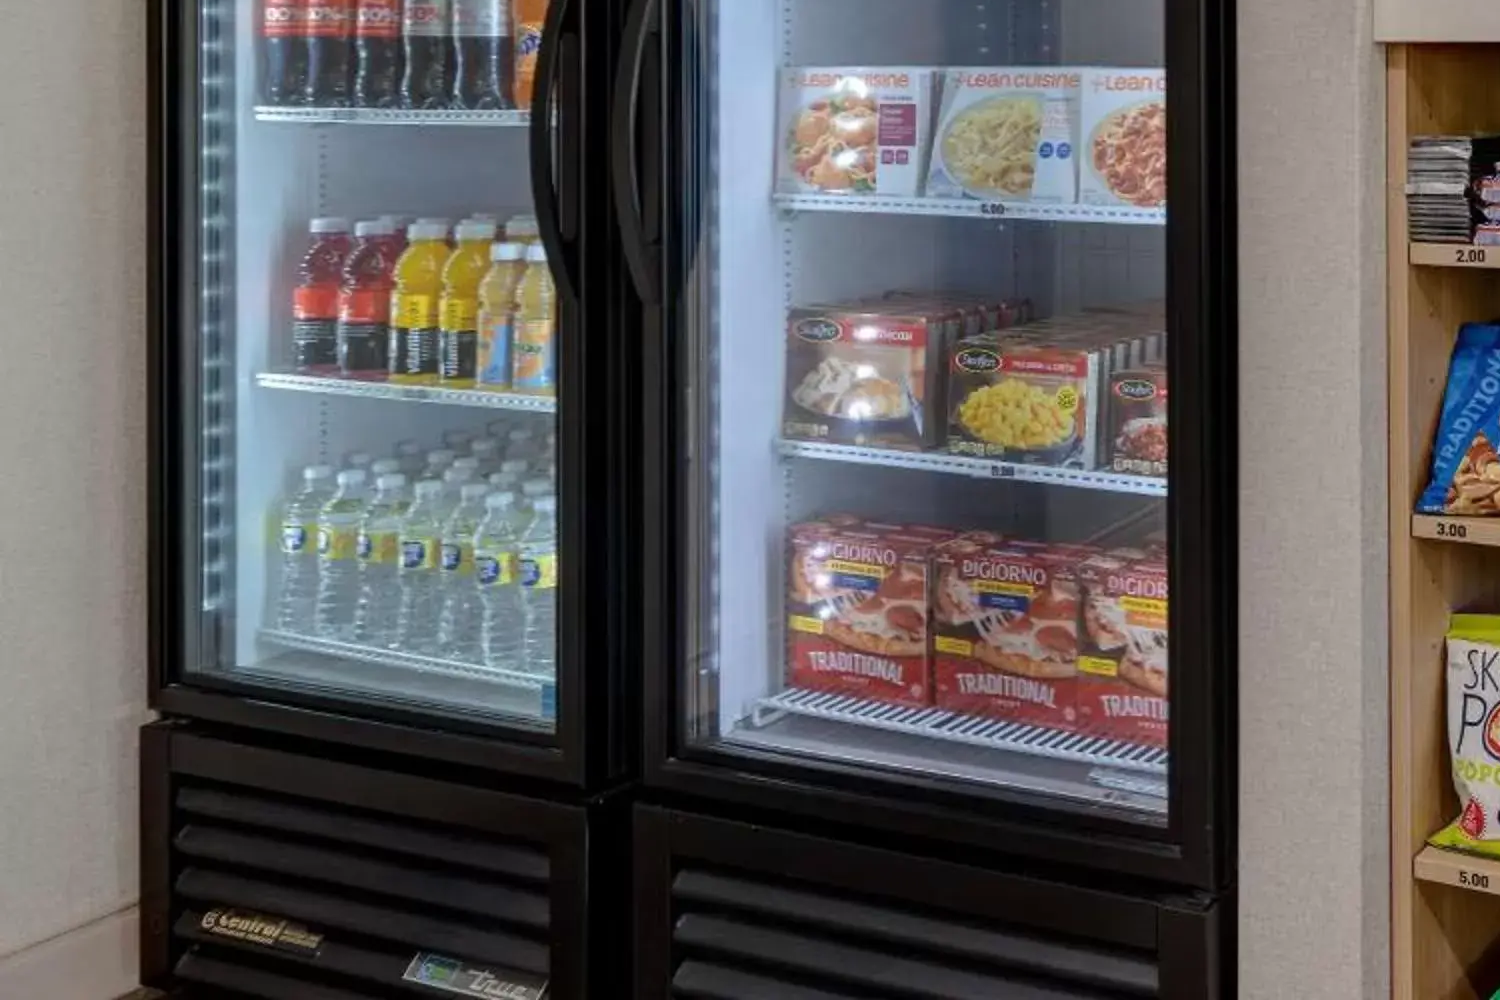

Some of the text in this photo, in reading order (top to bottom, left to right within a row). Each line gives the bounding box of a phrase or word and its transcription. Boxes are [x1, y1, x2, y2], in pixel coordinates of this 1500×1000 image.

[966, 71, 1080, 88] Lean cuisine
[1105, 75, 1151, 91] Lean
[1456, 250, 1486, 263] 2.00
[1437, 523, 1467, 538] 3.00
[808, 650, 905, 687] TRADITIONAL
[955, 673, 1057, 709] TRADITIONAL
[1459, 871, 1489, 888] 5.00
